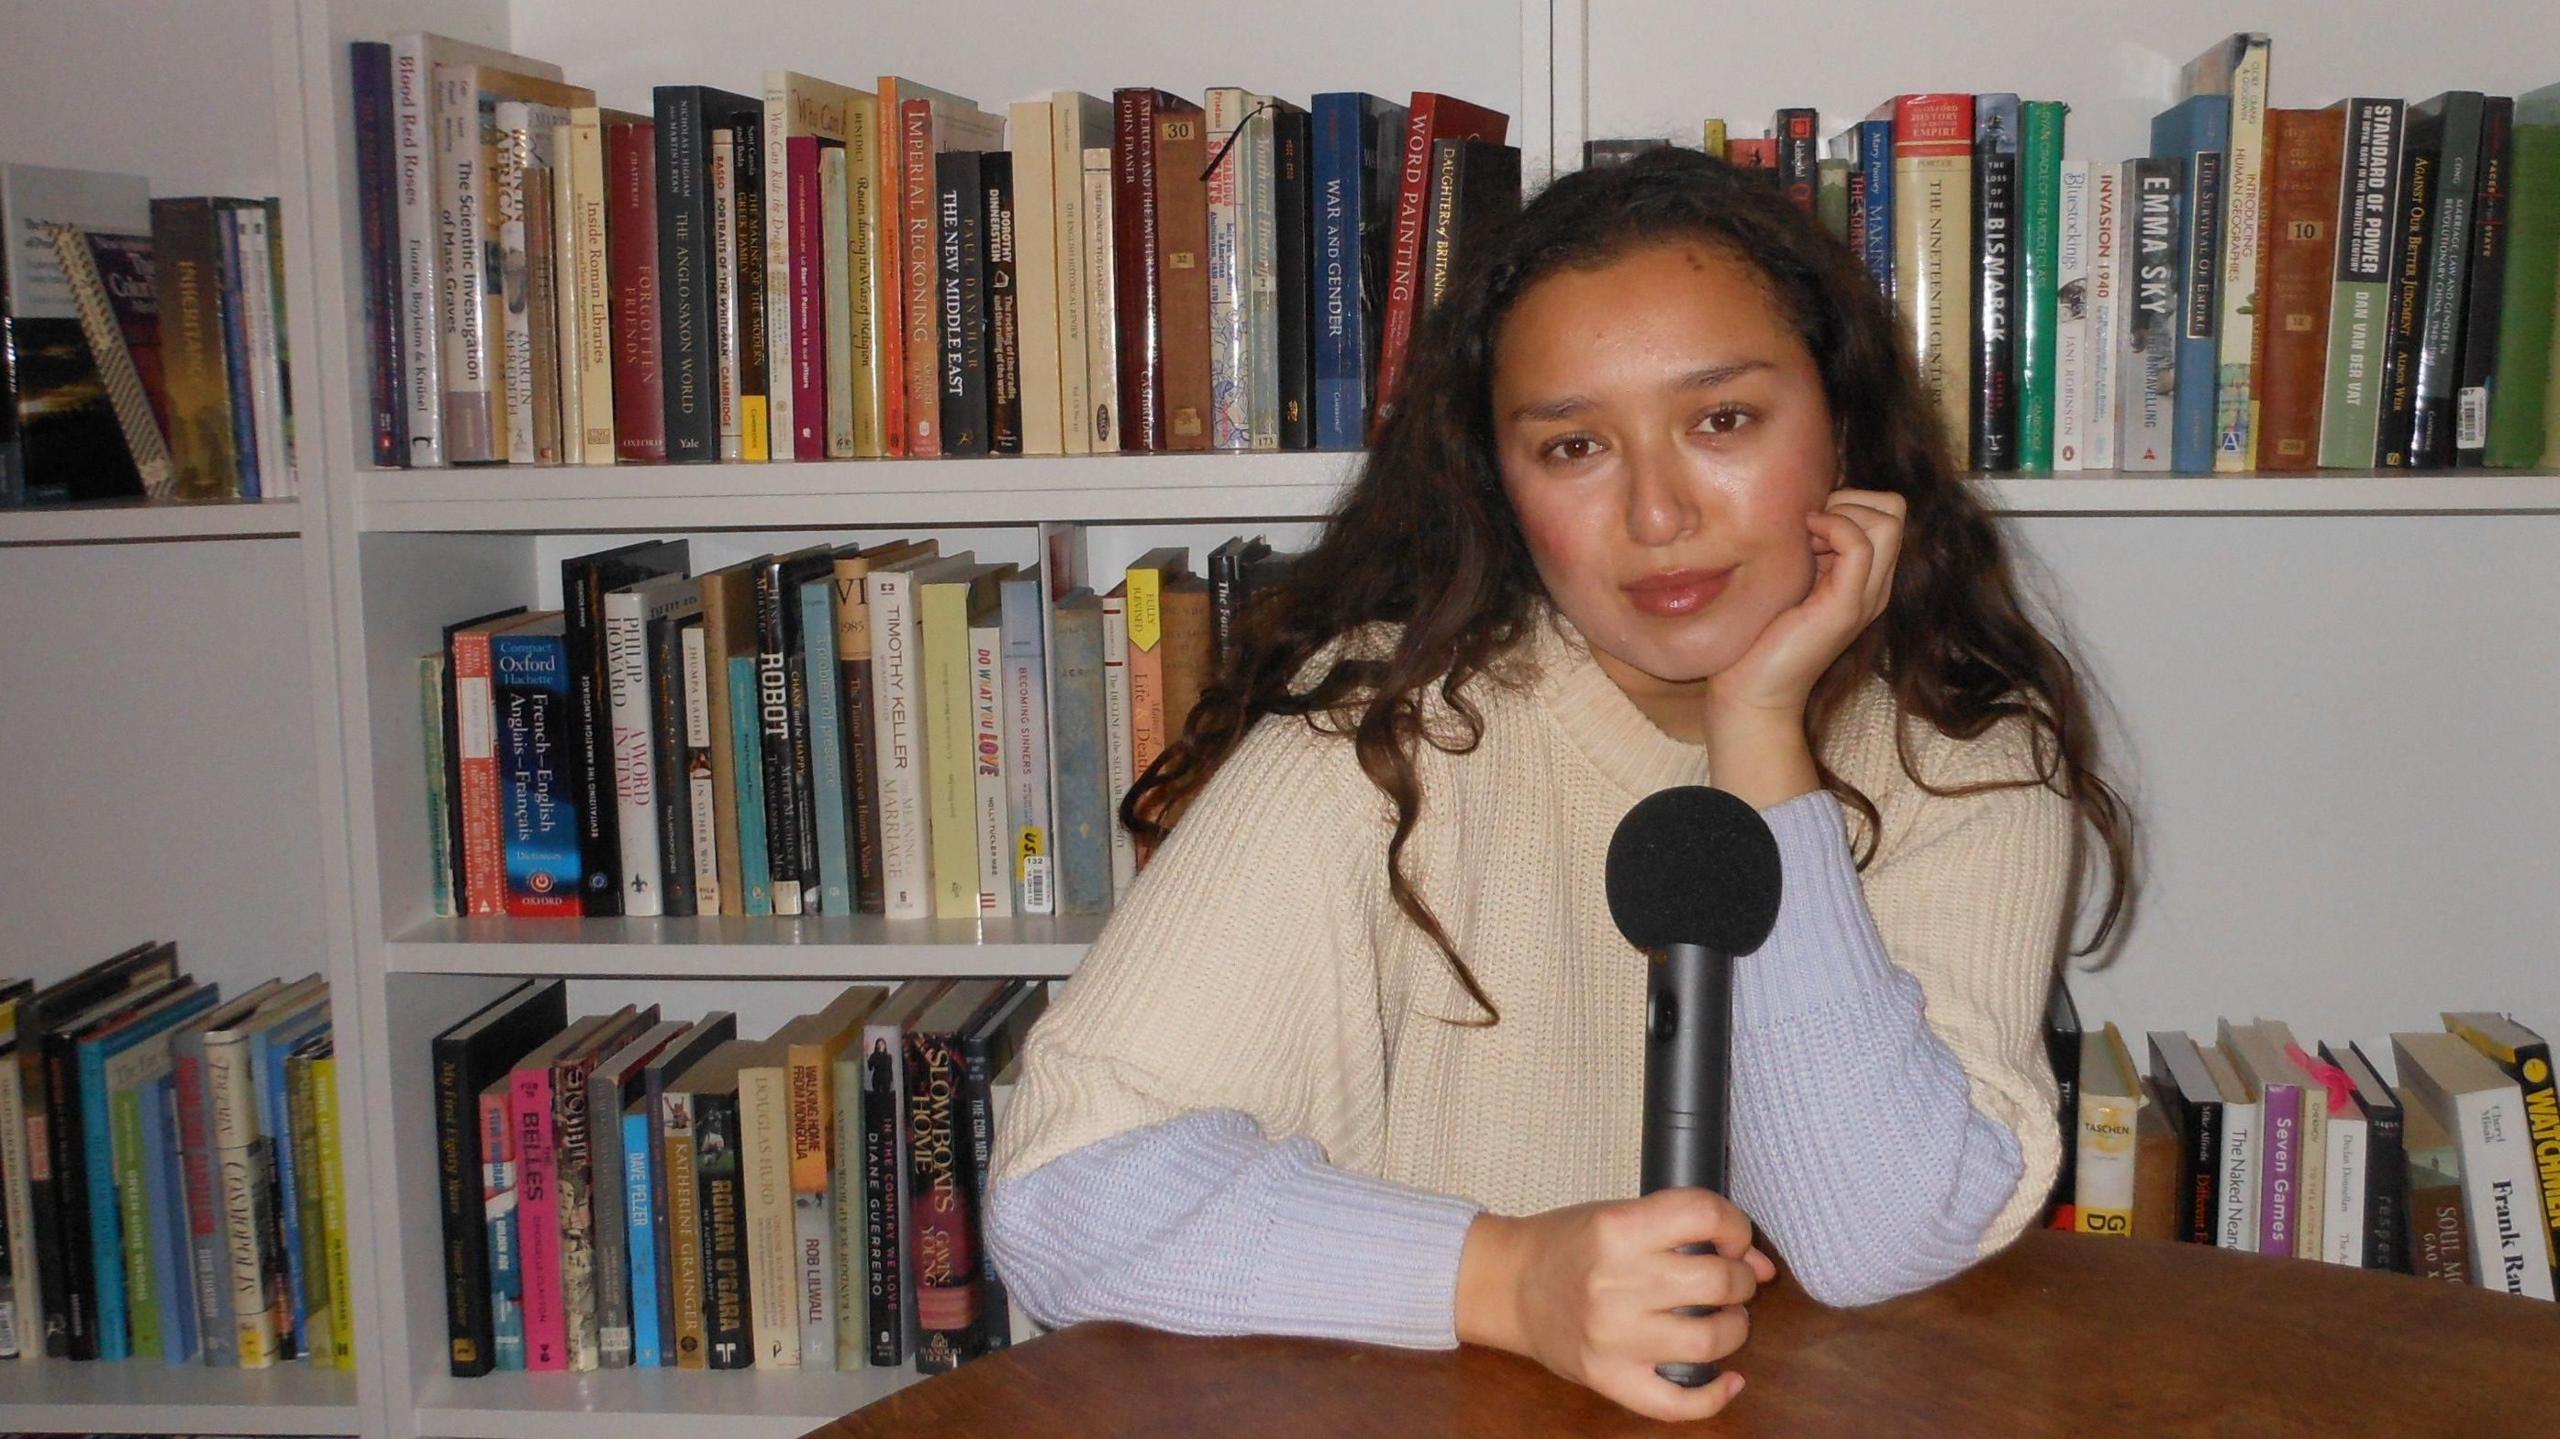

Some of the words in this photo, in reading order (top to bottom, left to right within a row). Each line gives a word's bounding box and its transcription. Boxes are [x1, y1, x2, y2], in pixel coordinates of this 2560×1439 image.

[400, 56, 416, 107] Blood
[402, 113, 417, 150] Red
[770, 112, 785, 136] Who
[1123, 98, 1135, 132] JOHN
[1168, 124, 1189, 138] 30
[771, 142, 783, 165] Can
[909, 111, 925, 210] IMPERIAL
[1124, 136, 1135, 184] FRASER
[1407, 114, 1427, 183] WORD
[2233, 149, 2244, 195] HUMAN
[2369, 106, 2391, 189] STANDARD
[405, 156, 419, 205] Roses
[457, 162, 473, 191] The
[495, 128, 513, 227] AFRICA
[716, 156, 724, 189] BASSO
[771, 170, 784, 194] Ride
[854, 177, 868, 217] Rouen
[1439, 148, 1454, 225] DAUGHTERS
[441, 210, 456, 224] of
[772, 198, 784, 217] the
[944, 190, 957, 226] THE
[1326, 180, 1342, 218] WAR
[1930, 182, 1941, 213] THE
[2064, 173, 2085, 270] Bluestockings
[2100, 175, 2113, 258] INVASION
[2143, 178, 2170, 253] EMMA
[2243, 174, 2256, 257] INTRODUCING
[2367, 194, 2385, 212] OF
[460, 195, 477, 269] Scientific
[587, 202, 601, 244] Inside
[675, 213, 689, 241] THE
[717, 198, 727, 252] PORTRAITS
[769, 220, 785, 264] Dragon?
[851, 220, 869, 256] during
[964, 219, 975, 265] PAUL
[990, 189, 1001, 262] DINNERSTEIN
[1001, 211, 1011, 262] DOROTHY
[1328, 226, 1339, 257] AND
[1392, 192, 1419, 301] PAINTING
[1438, 227, 1448, 236] of
[2229, 199, 2242, 282] GEOGRAPHIES
[2295, 224, 2314, 238] 10
[2362, 218, 2382, 273] POWER
[444, 228, 457, 273] Mass
[589, 249, 604, 299] Roman
[719, 256, 728, 270] OF
[857, 258, 869, 273] the
[945, 231, 958, 271] NEW
[1433, 240, 1448, 306] BRITANN
[1929, 219, 1941, 327] NINETEENTH
[677, 247, 692, 352] ANGLO-SAXON
[858, 276, 870, 304] Wars
[911, 220, 928, 342] RECKONING
[1328, 263, 1342, 336] GENDER
[1988, 218, 2004, 342] BISMARCK
[2097, 265, 2110, 298] 1940
[2141, 266, 2166, 316] SKY
[445, 278, 459, 333] Graves
[462, 273, 480, 380] Investigation
[625, 287, 638, 364] FRIENDS
[639, 266, 654, 383] FORGOTTEN
[854, 306, 871, 315] of
[946, 278, 960, 348] MIDDLE
[966, 278, 978, 368] DANAHAR
[2355, 292, 2370, 318] DAN
[591, 303, 606, 364] Libraries
[854, 319, 871, 366] Religion
[2352, 324, 2367, 349] VAN
[505, 329, 518, 416] MEREDITH
[518, 332, 533, 405] MARTIN
[680, 358, 694, 414] WORLD
[948, 352, 962, 396] EAST
[1930, 332, 1941, 405] CENTURY
[2350, 355, 2364, 378] DER
[722, 367, 730, 427] CAMBRIDGE
[2145, 357, 2159, 428] UNRAVELLING
[2347, 382, 2361, 405] VAT
[679, 439, 700, 449] Yale
[1133, 587, 1144, 632] REVISED
[1146, 594, 1156, 624] FULLY
[500, 656, 555, 671] Oxford
[606, 617, 626, 707] HOWARD
[624, 617, 642, 683] PHILIP
[886, 606, 902, 689] TIMOTHY
[978, 649, 991, 665] DO
[761, 652, 787, 738] ROBOT
[980, 669, 992, 701] WHAT
[1018, 668, 1028, 723] BECOMING
[1134, 674, 1148, 702] Life
[614, 727, 627, 746] IN
[631, 727, 645, 738] A
[892, 697, 907, 768] KELLER
[982, 706, 994, 728] YOU
[1136, 708, 1148, 720] &
[632, 742, 649, 806] WORD
[980, 734, 998, 777] LOVE
[1021, 728, 1032, 774] SINNERS
[1137, 728, 1151, 774] Death
[617, 752, 630, 802] TIME
[883, 778, 902, 878] MARRIAGE
[794, 1065, 806, 1097] FROM
[806, 1065, 818, 1116] WALKING
[930, 1049, 949, 1124] SLOW
[795, 1100, 809, 1160] MONGOLIA
[807, 1118, 820, 1151] HOME
[883, 1118, 892, 1133] IN
[912, 1096, 932, 1175] HOME
[2086, 1123, 2129, 1134] TASCHEN
[2232, 1130, 2246, 1155] The
[2275, 1119, 2292, 1172] Seven
[523, 1112, 543, 1200] BELLES
[631, 1153, 646, 1180] DAVE
[868, 1133, 880, 1190] DIANE
[883, 1140, 894, 1166] THE
[933, 1127, 953, 1213] BOATS
[632, 1184, 647, 1227] PELZER
[676, 1144, 692, 1238] KATHERINE
[2228, 1160, 2245, 1203] Naked
[226, 1162, 254, 1293] COSMOPOLIS
[712, 1180, 735, 1253] RONAN
[885, 1173, 896, 1240] COUNTRY
[2272, 1180, 2288, 1240] Games
[2437, 1207, 2458, 1254] SOUL
[2492, 1180, 2520, 1248] Frank
[806, 1239, 820, 1266] ROB
[869, 1199, 882, 1295] GUERRERO
[887, 1248, 896, 1269] WE
[921, 1224, 936, 1286] YOUNG
[936, 1231, 950, 1282] GAVIN
[2424, 1233, 2437, 1261] GAO
[681, 1244, 697, 1330] GRAINGER
[717, 1259, 739, 1331] O'GARA
[808, 1271, 822, 1324] LILWALL
[887, 1276, 896, 1311] LOVE
